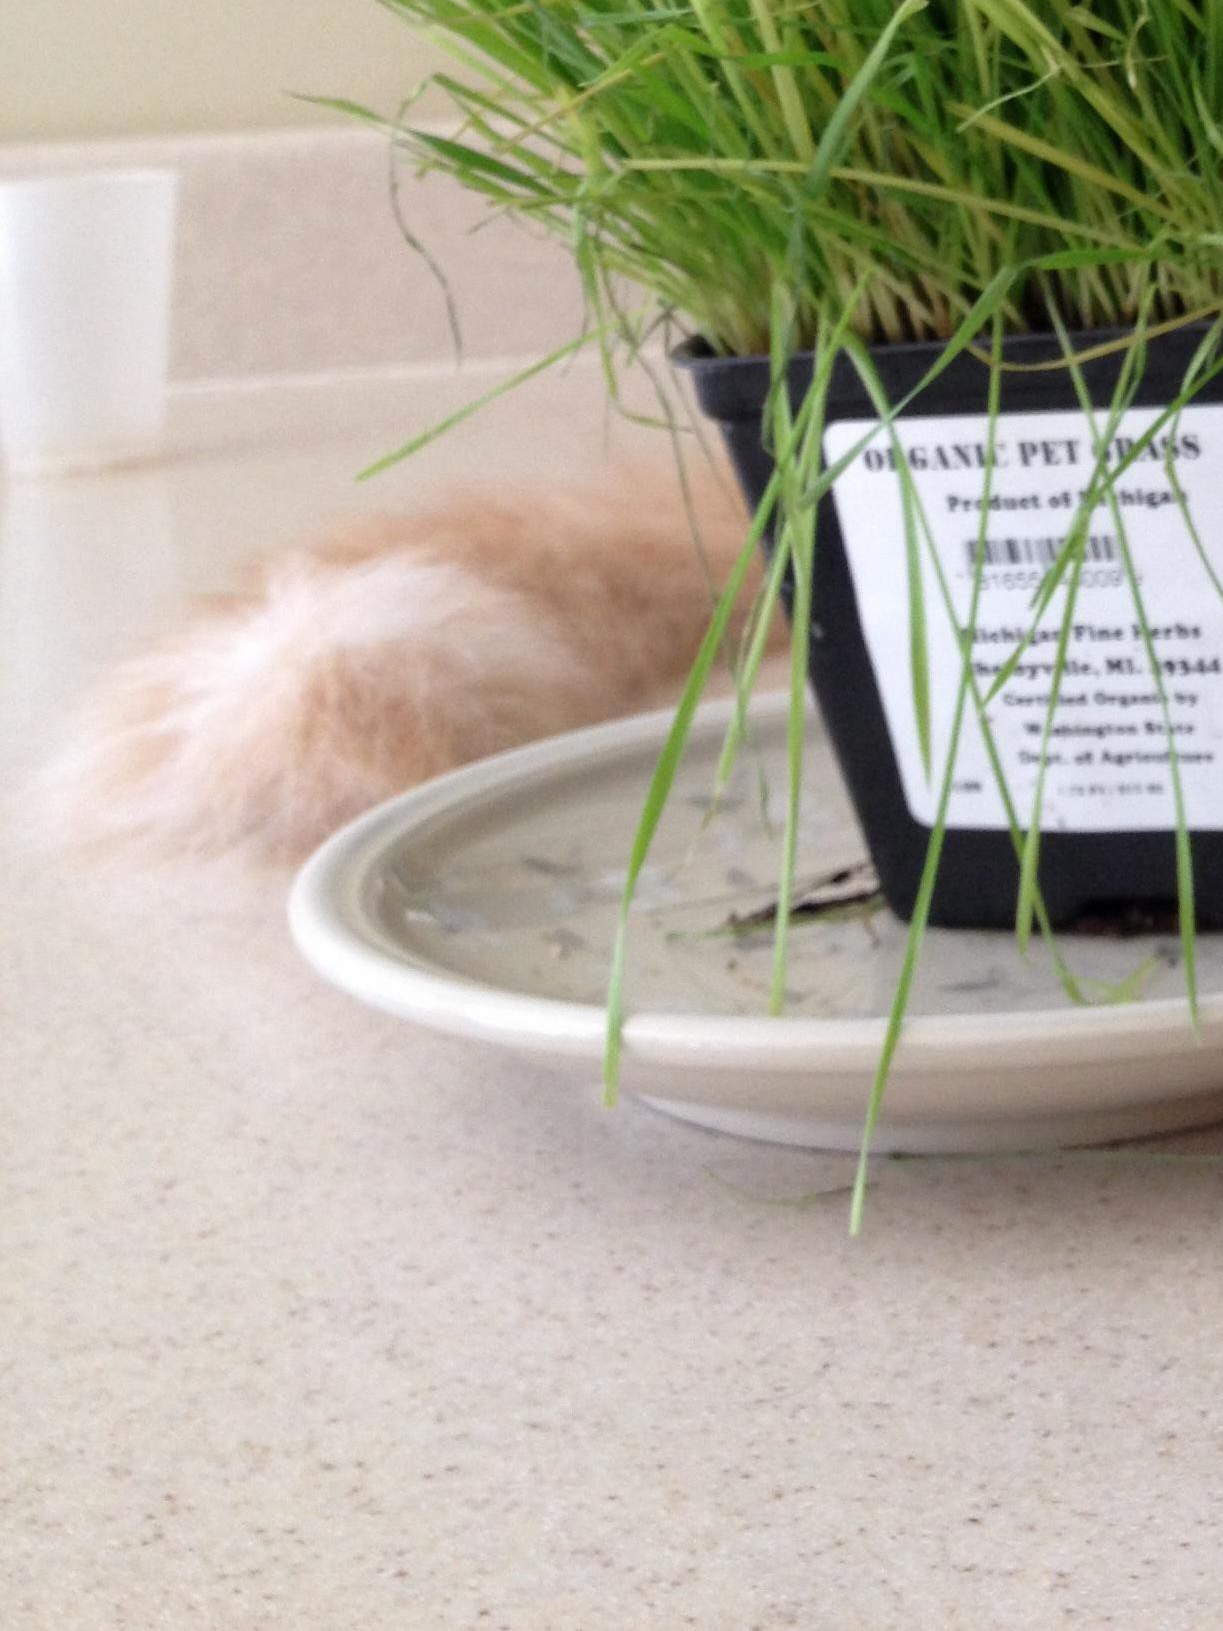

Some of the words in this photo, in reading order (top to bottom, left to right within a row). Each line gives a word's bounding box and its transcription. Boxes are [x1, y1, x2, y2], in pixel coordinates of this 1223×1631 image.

[1018, 439, 1079, 467] PET
[1048, 491, 1071, 509] of
[1078, 489, 1187, 509] higa
[960, 626, 1062, 646] ichian
[1074, 624, 1123, 641] Fine
[1149, 657, 1221, 676] 9344
[1003, 692, 1087, 707] Certiied
[1023, 722, 1138, 739] Wshington
[1101, 750, 1214, 766] Agriculure
